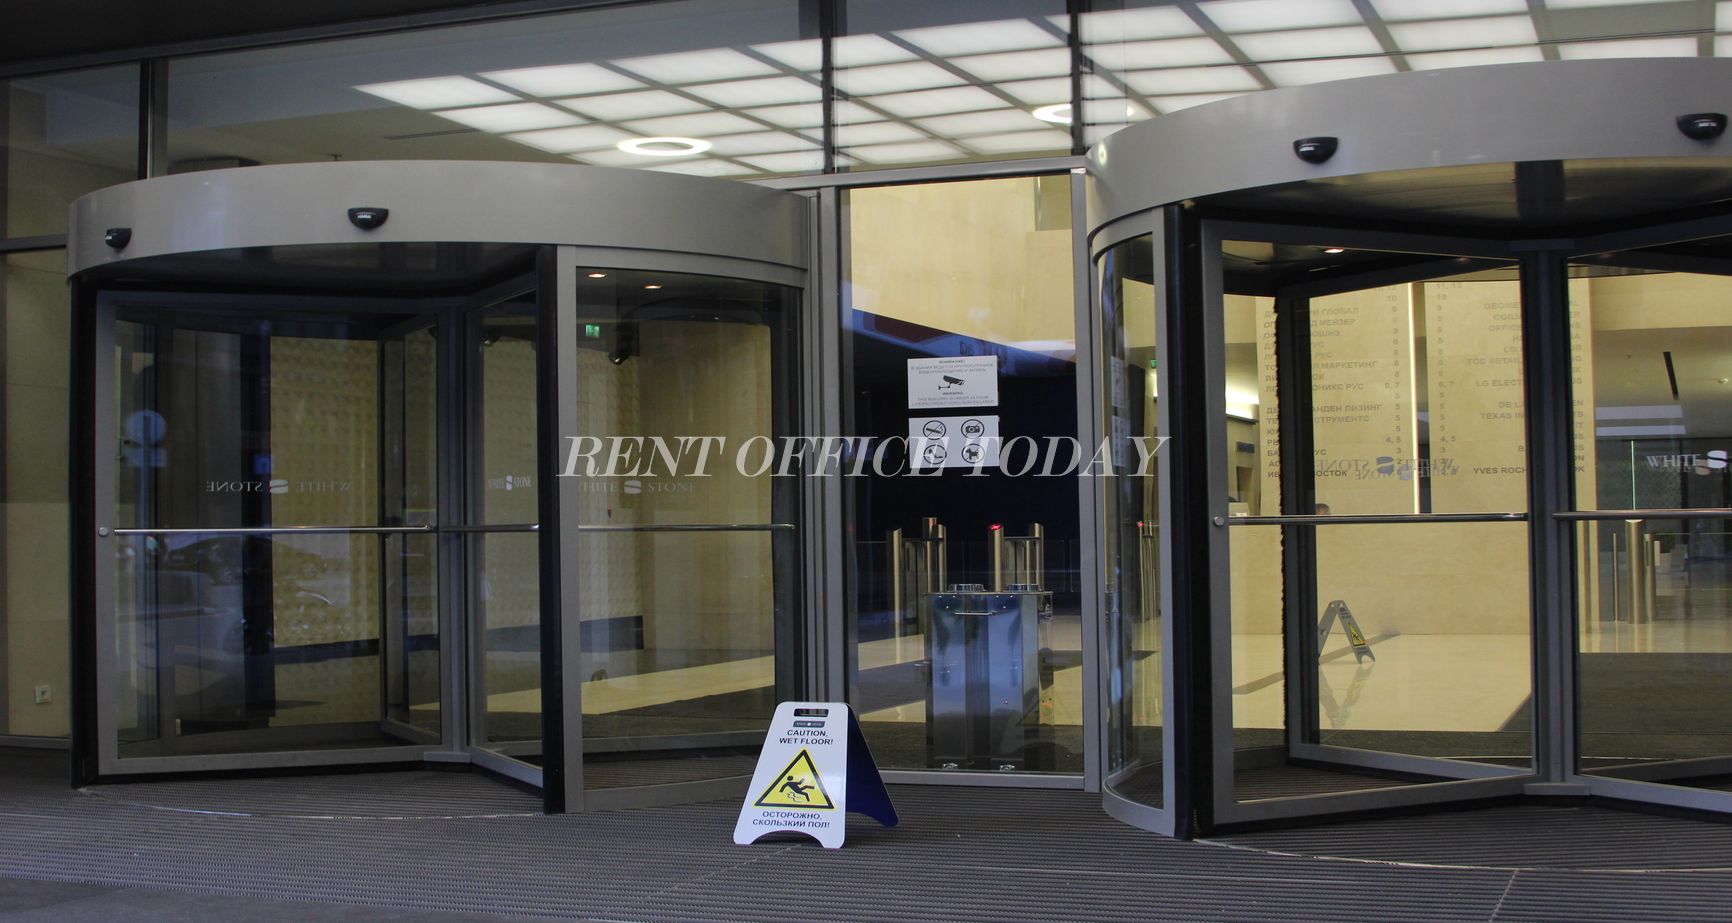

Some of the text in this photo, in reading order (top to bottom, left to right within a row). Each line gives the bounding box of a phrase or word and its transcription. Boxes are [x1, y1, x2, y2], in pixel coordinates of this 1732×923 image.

[1320, 360, 1377, 370] МАРКЕТИНГ
[1313, 415, 1370, 424] СТРУМЕНТС
[1473, 466, 1499, 475] YVES
[786, 729, 829, 738] CAUTION,
[779, 737, 834, 746] WET FLOOR!
[762, 810, 823, 820] ОСТОРОЖНО,
[752, 818, 831, 829] СКОЛЬЗКИЙ ПОЛ!
